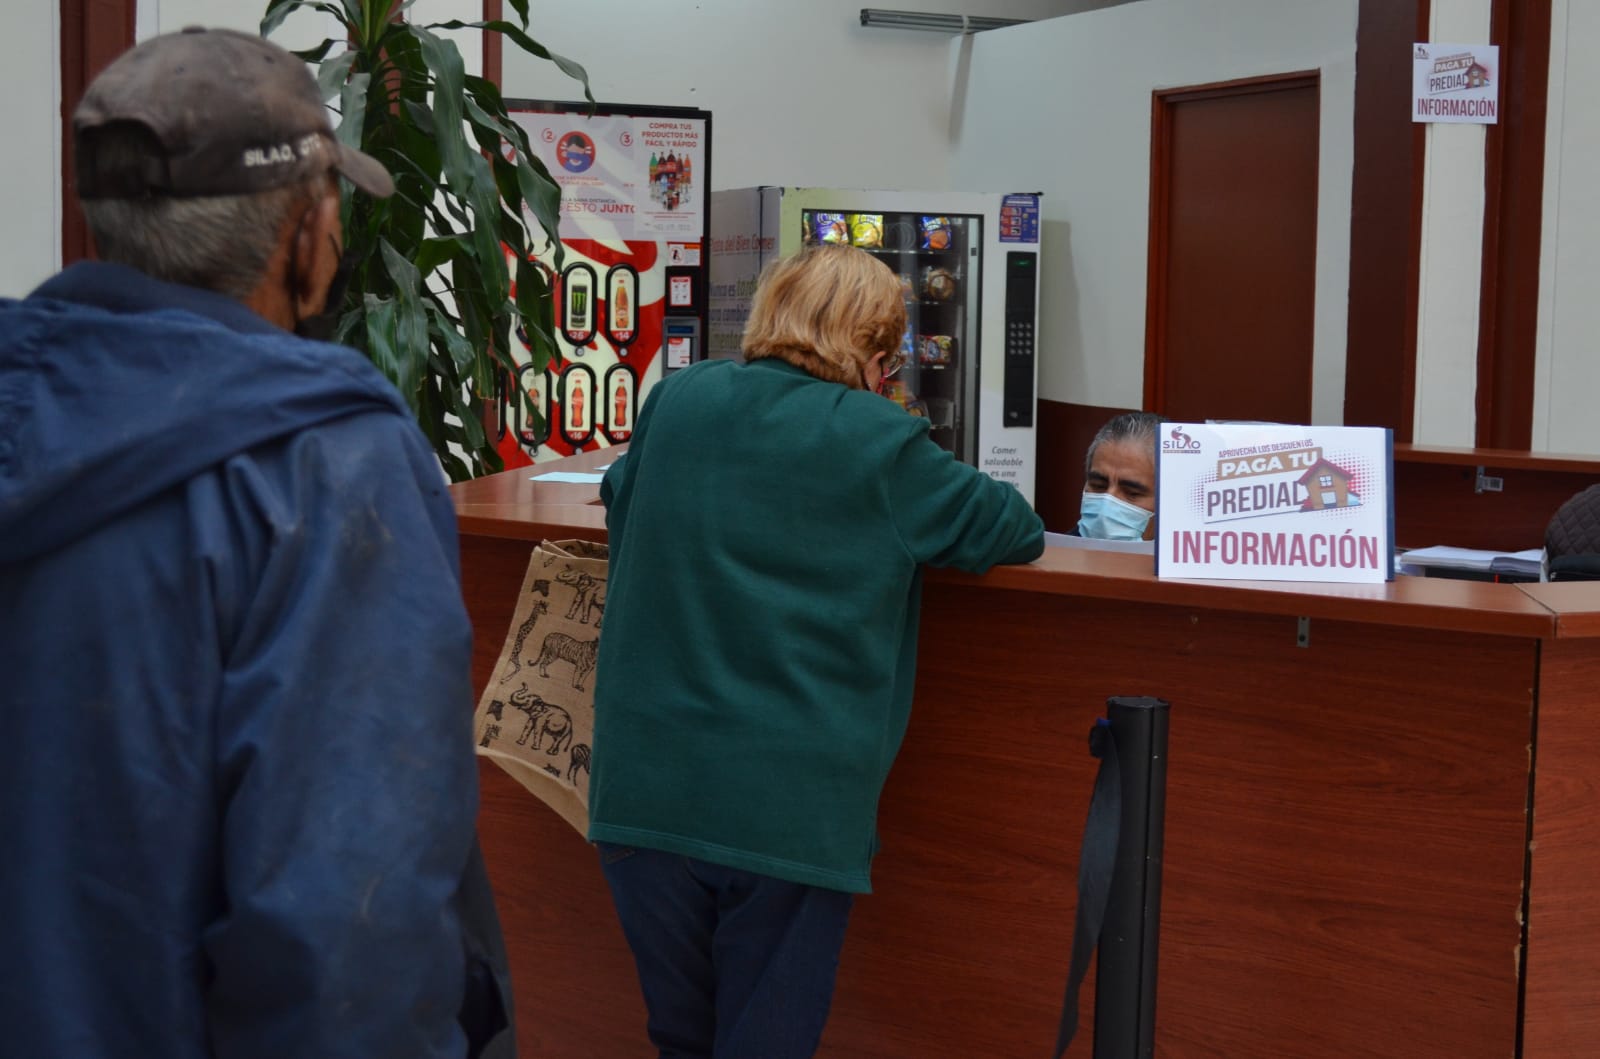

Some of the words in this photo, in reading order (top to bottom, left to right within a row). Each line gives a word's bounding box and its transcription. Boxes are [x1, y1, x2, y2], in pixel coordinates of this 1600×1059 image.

[1461, 58, 1473, 67] TU
[1417, 96, 1495, 117] INFORMACIÓN
[649, 122, 677, 130] COMPRA
[684, 131, 698, 139] MÁS
[672, 139, 697, 148] RÁPIDO
[566, 202, 597, 213] ESTO
[1162, 439, 1201, 450] SILAO
[1218, 446, 1258, 458] APROVECHA
[1258, 444, 1271, 453] LOS
[1271, 438, 1314, 452] DESCUENTOS
[992, 446, 1017, 455] Comer
[984, 458, 1023, 466] saludable
[1221, 454, 1283, 478] PAGA
[1288, 450, 1318, 469] TU
[1207, 480, 1306, 517] PREDIAL
[1172, 528, 1379, 569] INFORMACIÓN
